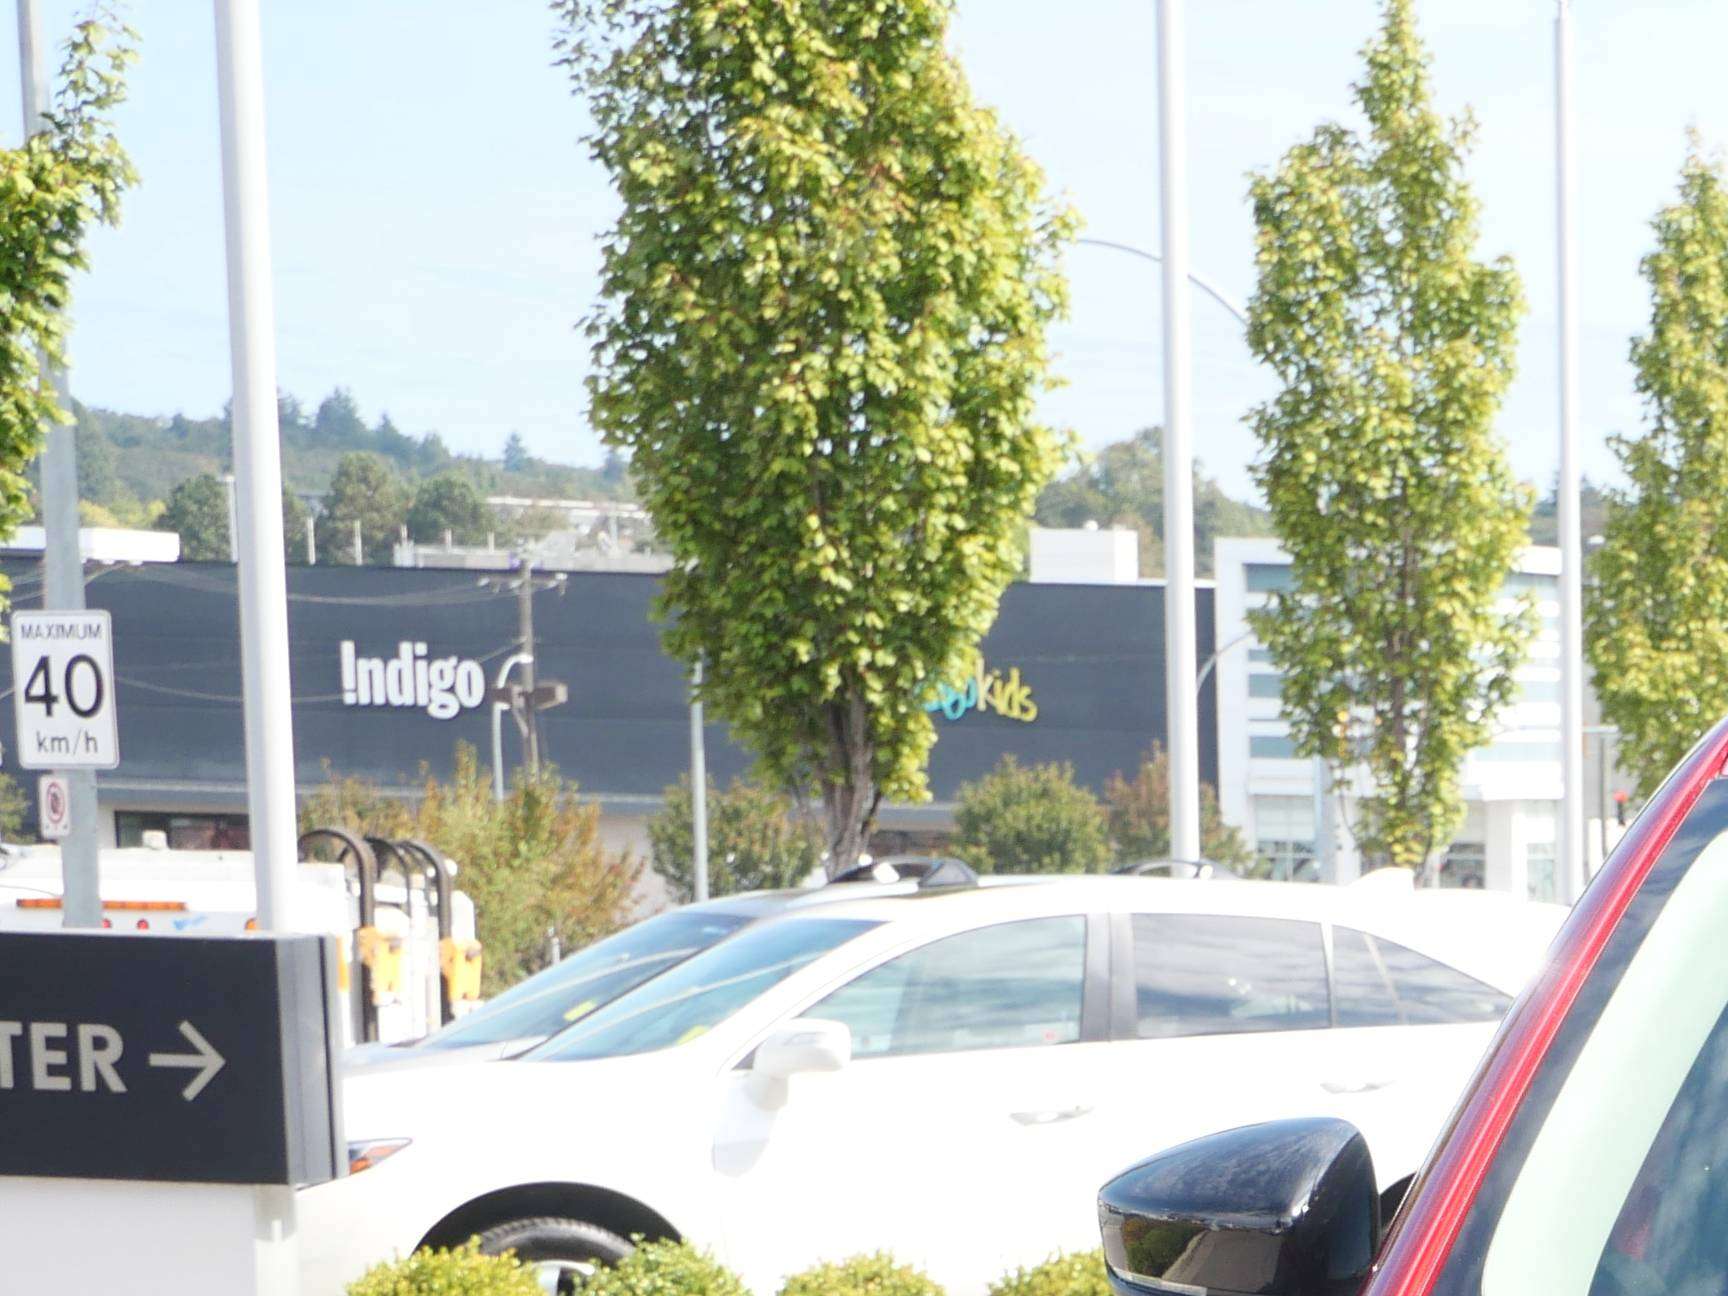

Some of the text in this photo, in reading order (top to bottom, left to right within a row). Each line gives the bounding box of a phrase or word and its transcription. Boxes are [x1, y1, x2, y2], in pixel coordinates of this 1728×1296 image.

[21, 623, 101, 640] MAXIMUM
[24, 653, 104, 719] 40
[36, 729, 98, 755] km/h
